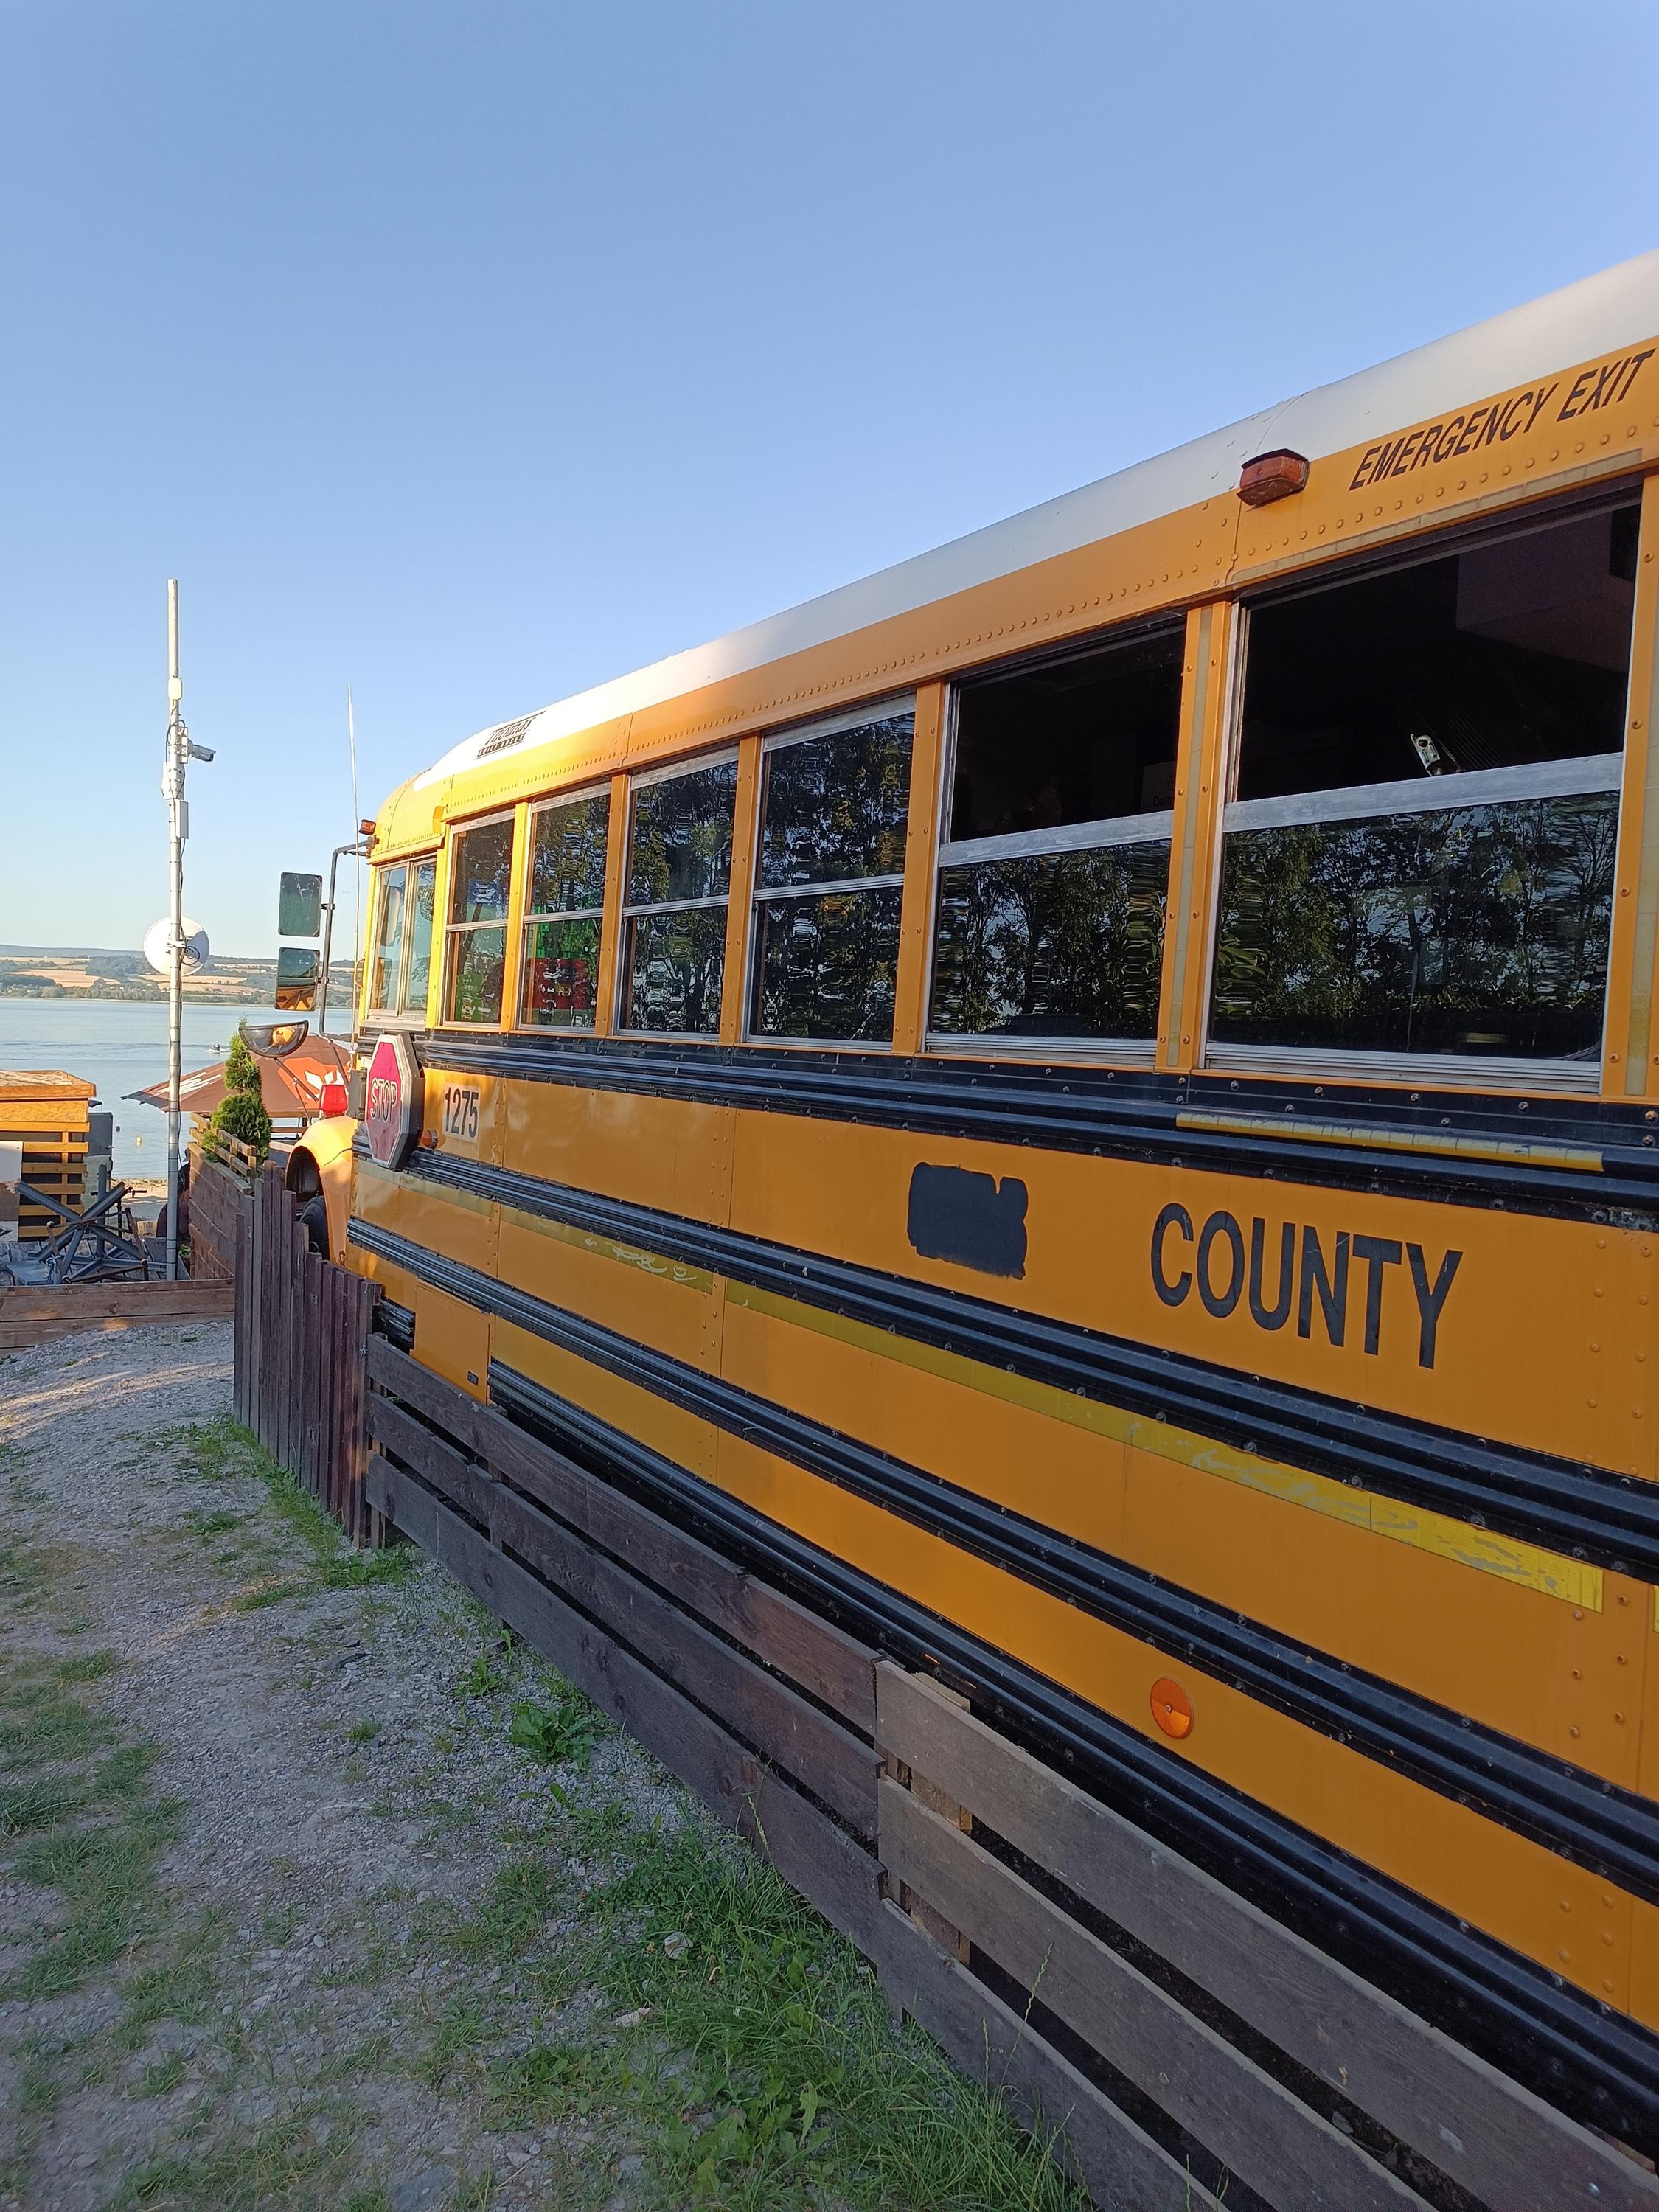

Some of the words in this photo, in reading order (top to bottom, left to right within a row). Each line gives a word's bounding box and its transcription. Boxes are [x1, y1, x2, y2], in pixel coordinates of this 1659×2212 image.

[1348, 381, 1561, 492] EMERGENCY
[1557, 348, 1657, 422] EXIT
[370, 1077, 397, 1123] STOP
[445, 1086, 479, 1138] 1275
[1151, 1203, 1464, 1370] COUNTY
